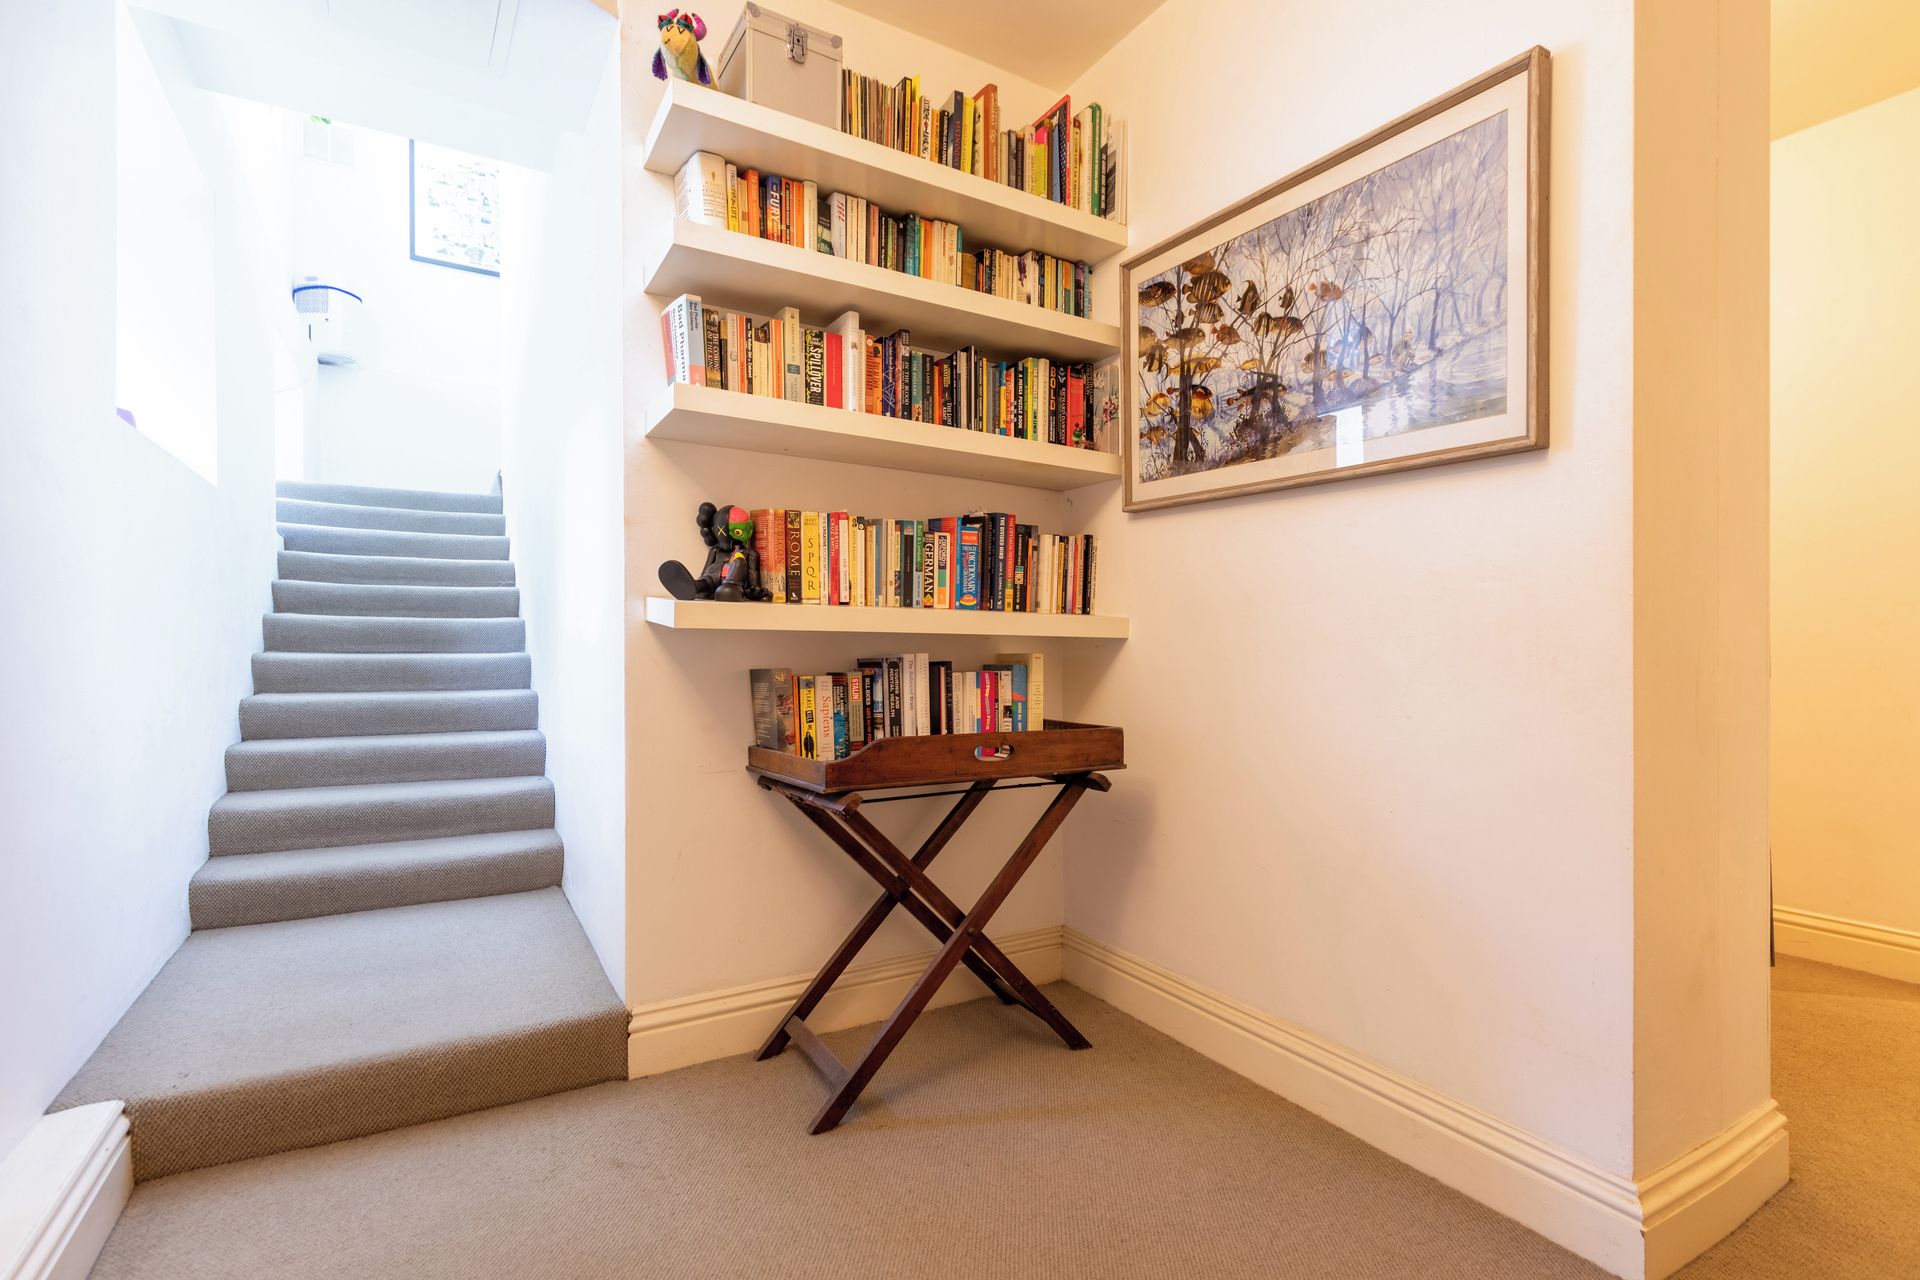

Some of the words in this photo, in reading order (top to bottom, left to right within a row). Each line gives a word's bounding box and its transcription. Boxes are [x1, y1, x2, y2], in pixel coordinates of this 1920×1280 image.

[770, 190, 780, 222] FURY
[679, 332, 687, 382] Pharma
[707, 331, 713, 339] OF
[810, 348, 822, 392] SPILLOVER
[904, 361, 909, 369] IN
[776, 516, 784, 564] RUBICON
[790, 531, 800, 576] ROME
[806, 538, 817, 590] SPQR
[924, 543, 934, 593] GERMAN
[968, 551, 976, 593] DICTIONARY
[820, 696, 831, 738] Sapiens
